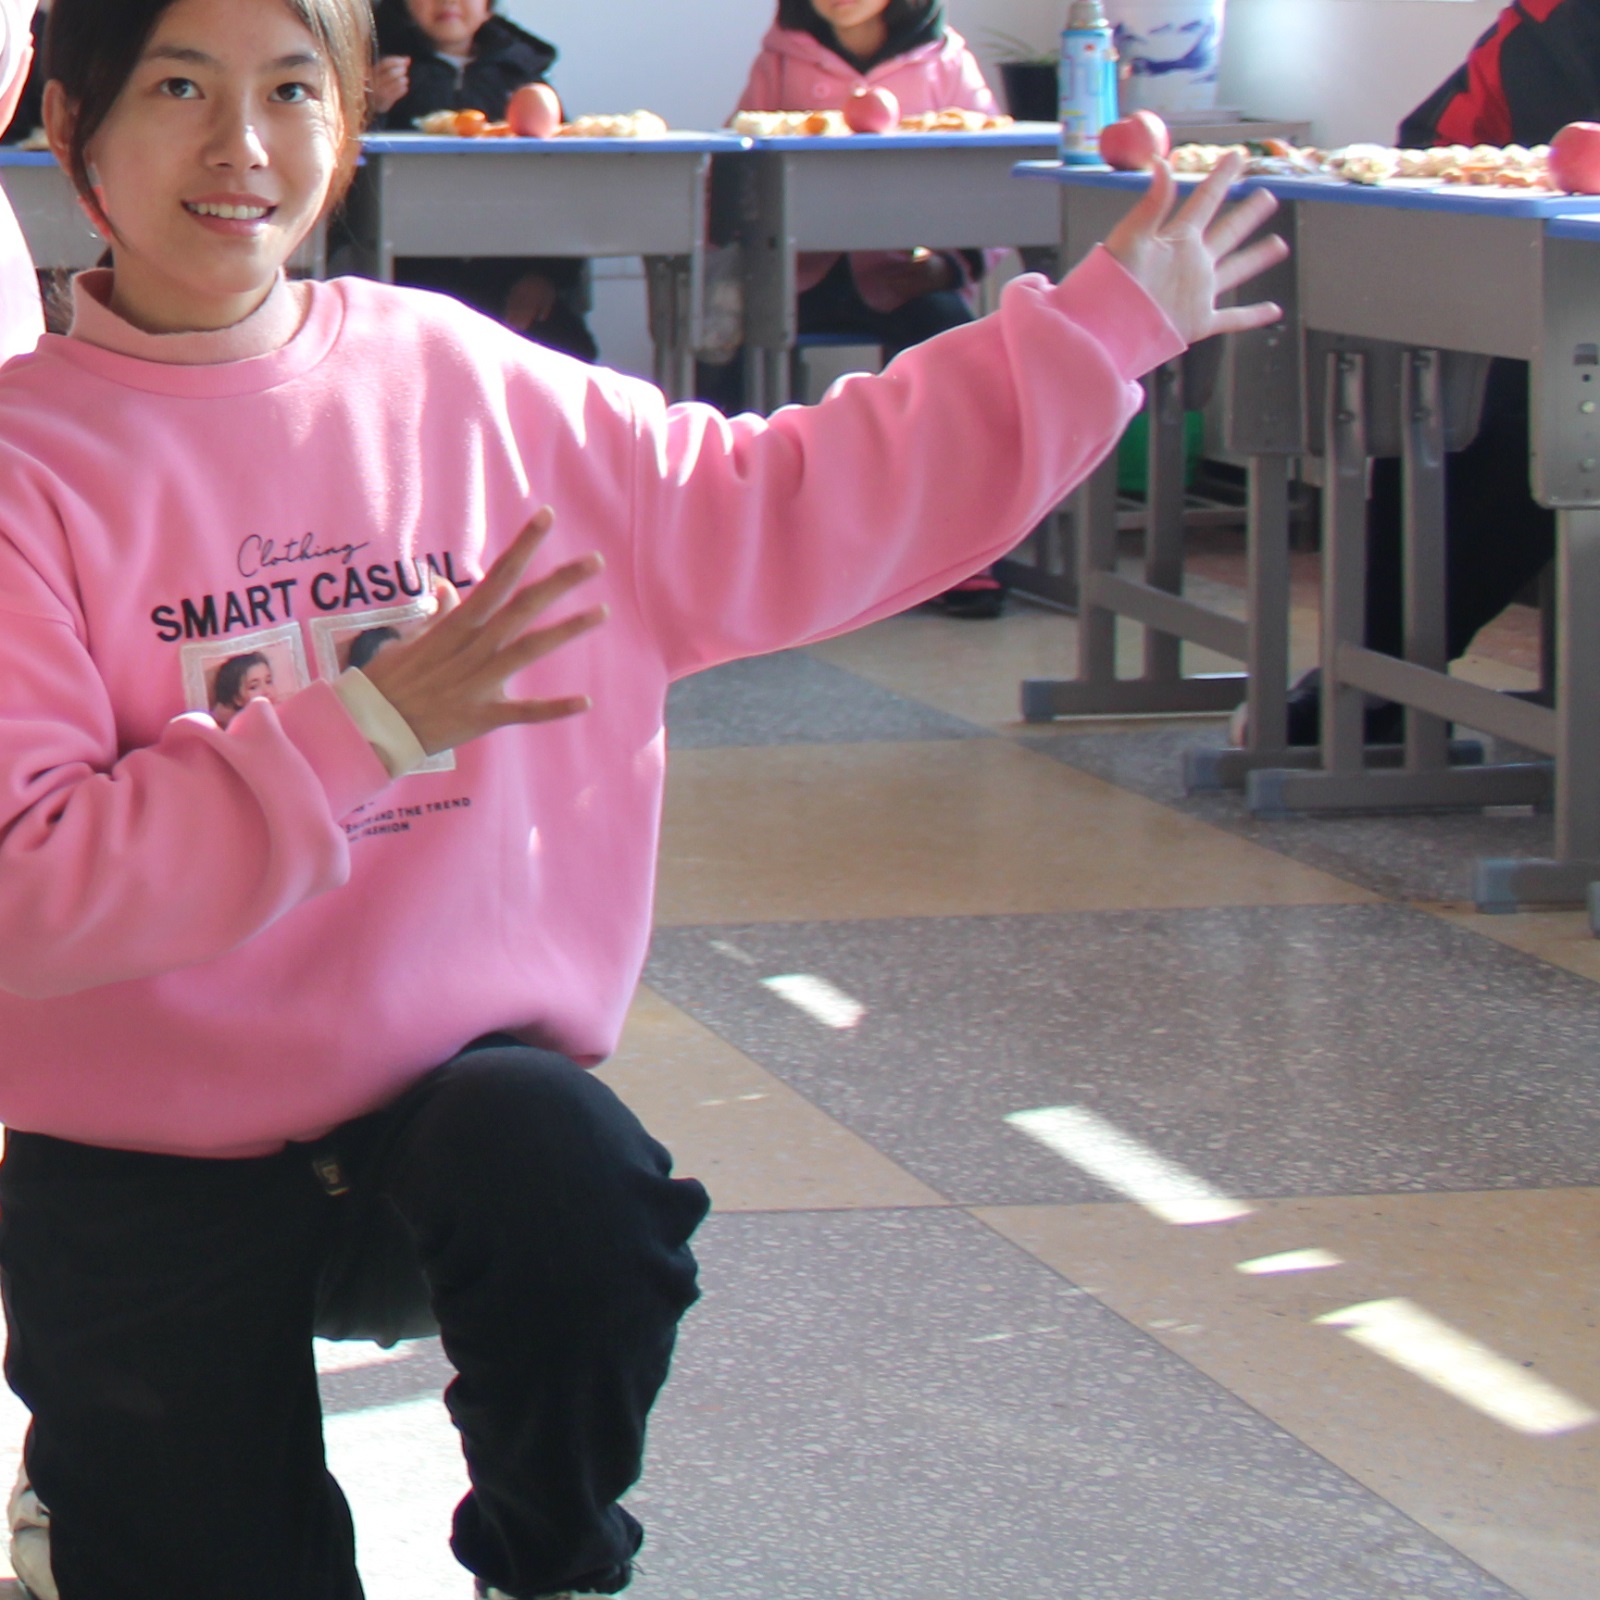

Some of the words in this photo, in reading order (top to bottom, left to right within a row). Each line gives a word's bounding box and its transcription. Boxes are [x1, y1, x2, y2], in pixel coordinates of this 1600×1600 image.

[236, 531, 371, 578] Clothing
[150, 577, 297, 642] SMART
[426, 796, 472, 813] TREND
